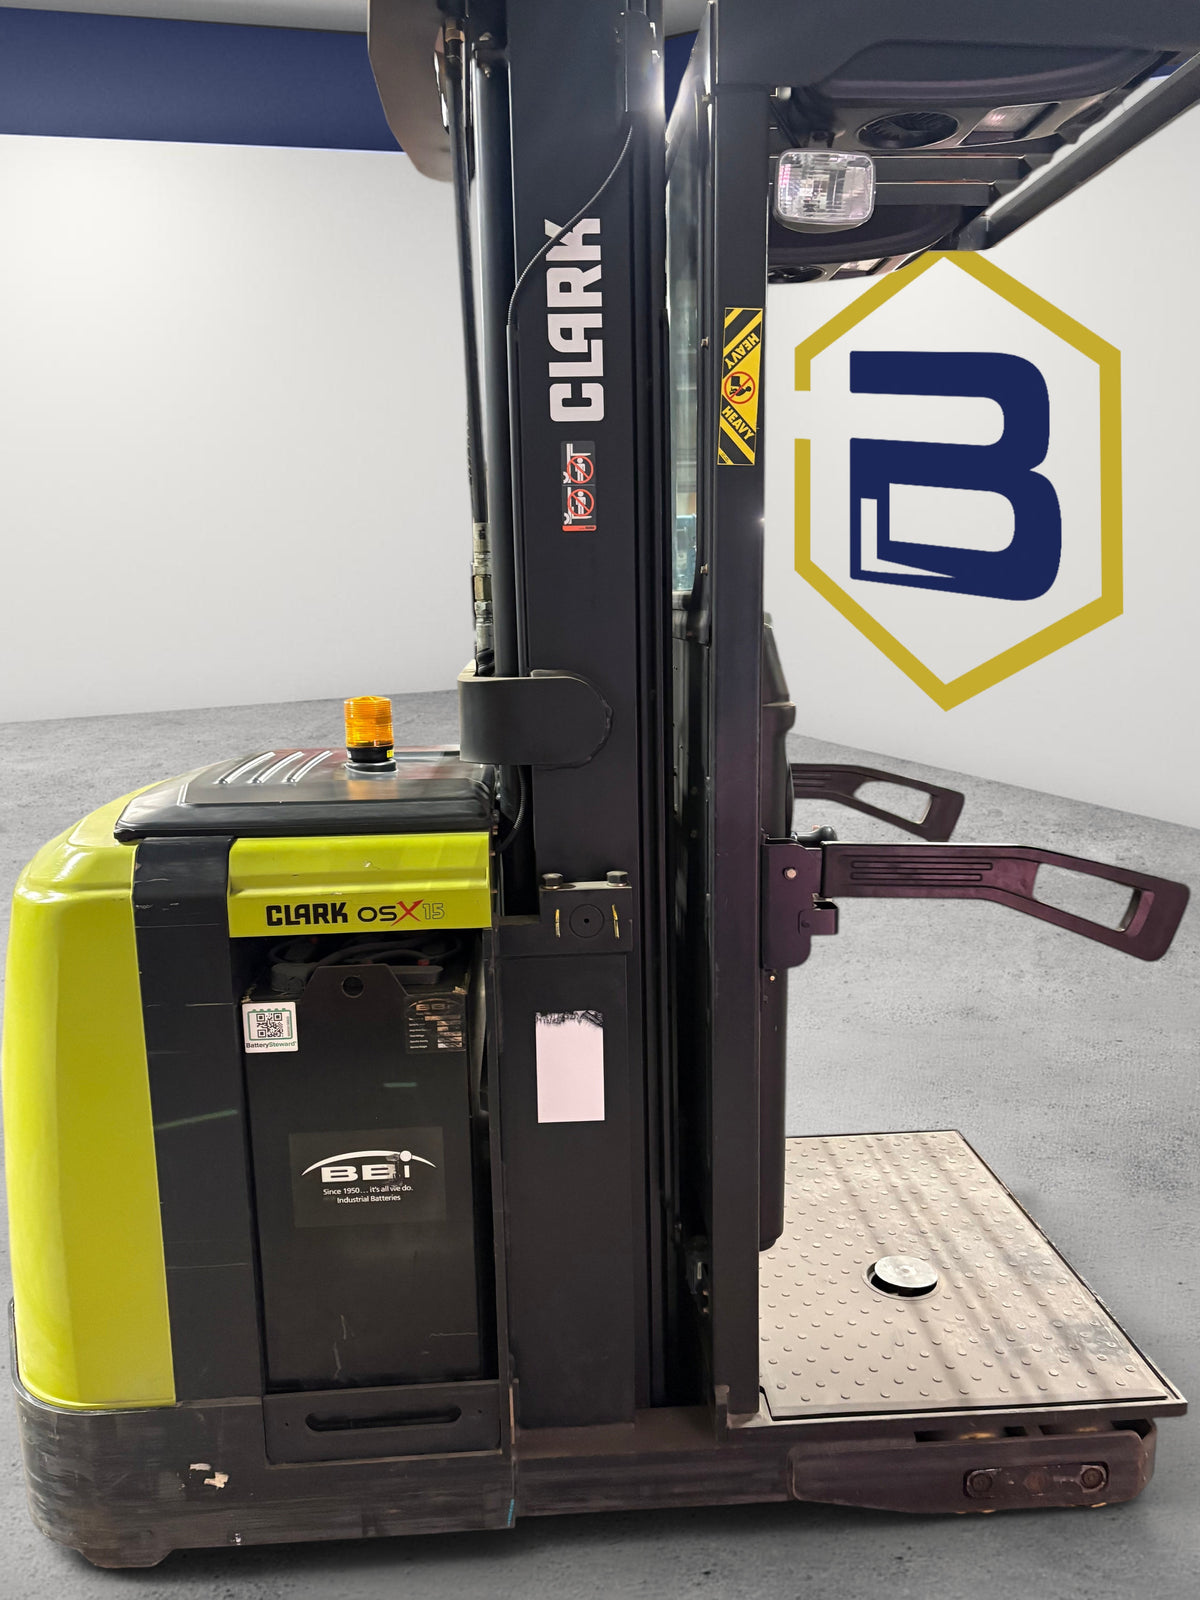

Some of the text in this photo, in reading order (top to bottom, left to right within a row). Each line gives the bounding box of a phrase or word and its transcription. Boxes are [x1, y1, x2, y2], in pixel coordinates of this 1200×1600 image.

[544, 218, 604, 422] CLARK
[724, 332, 760, 370] HEAVY
[721, 405, 755, 441] HEAVY
[850, 351, 1061, 600] B
[266, 902, 348, 926] CLARK
[369, 1185, 380, 1193] it's
